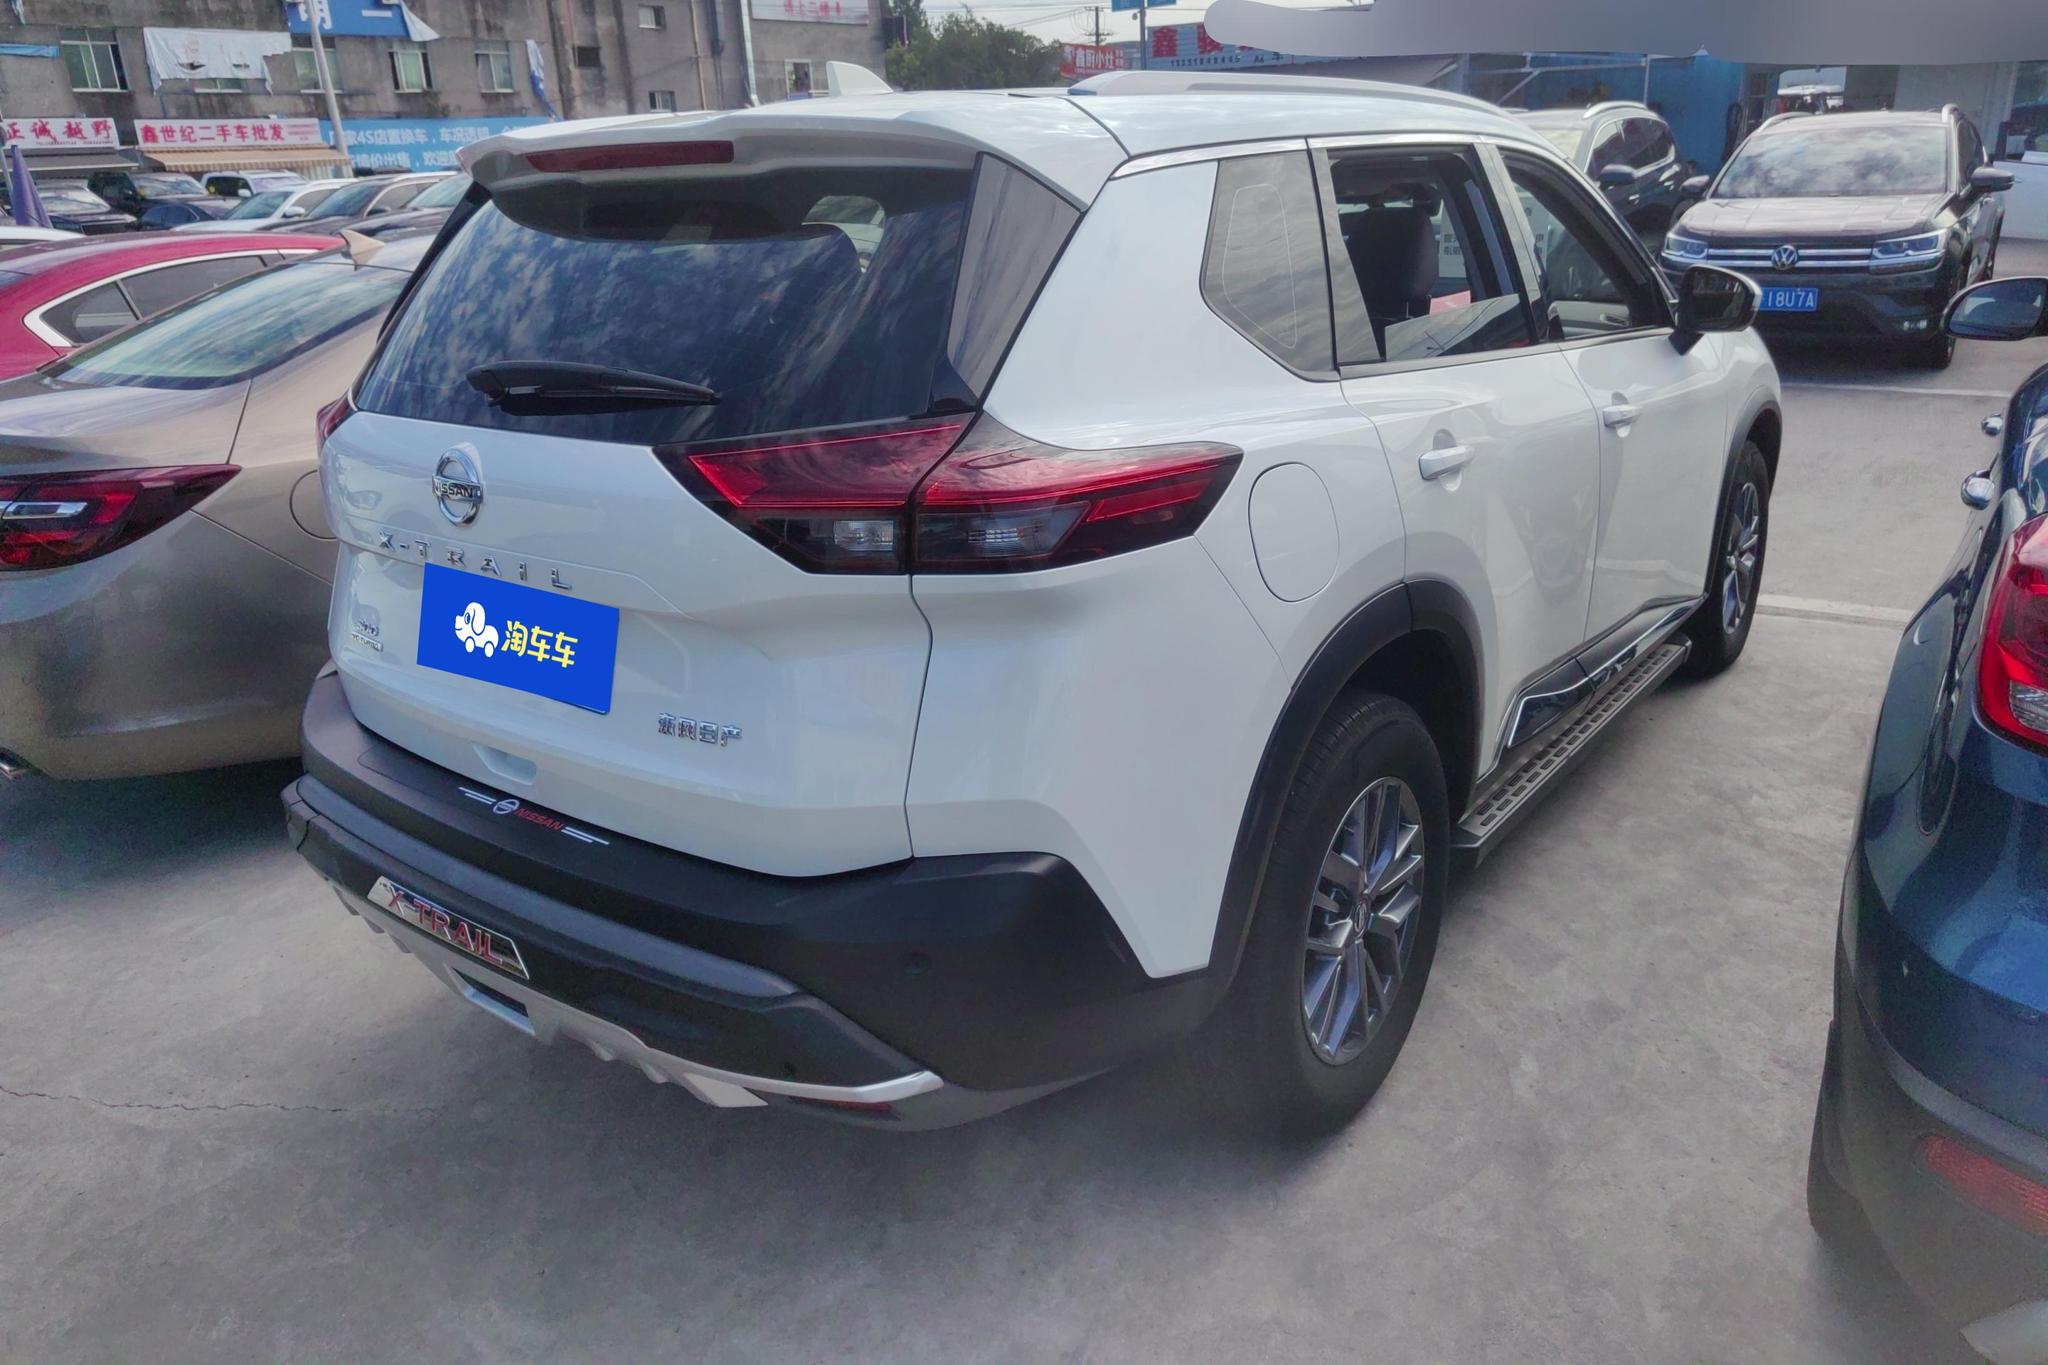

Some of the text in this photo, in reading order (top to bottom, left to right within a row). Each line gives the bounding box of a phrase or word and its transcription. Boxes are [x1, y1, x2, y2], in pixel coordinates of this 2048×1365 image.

[140, 123, 285, 144] 鑫世纪二手车批发
[434, 480, 474, 498] NISSAN
[379, 528, 573, 591] X-TRAIL
[514, 807, 564, 831] NISSAN
[387, 884, 503, 965] X-TRAIL
